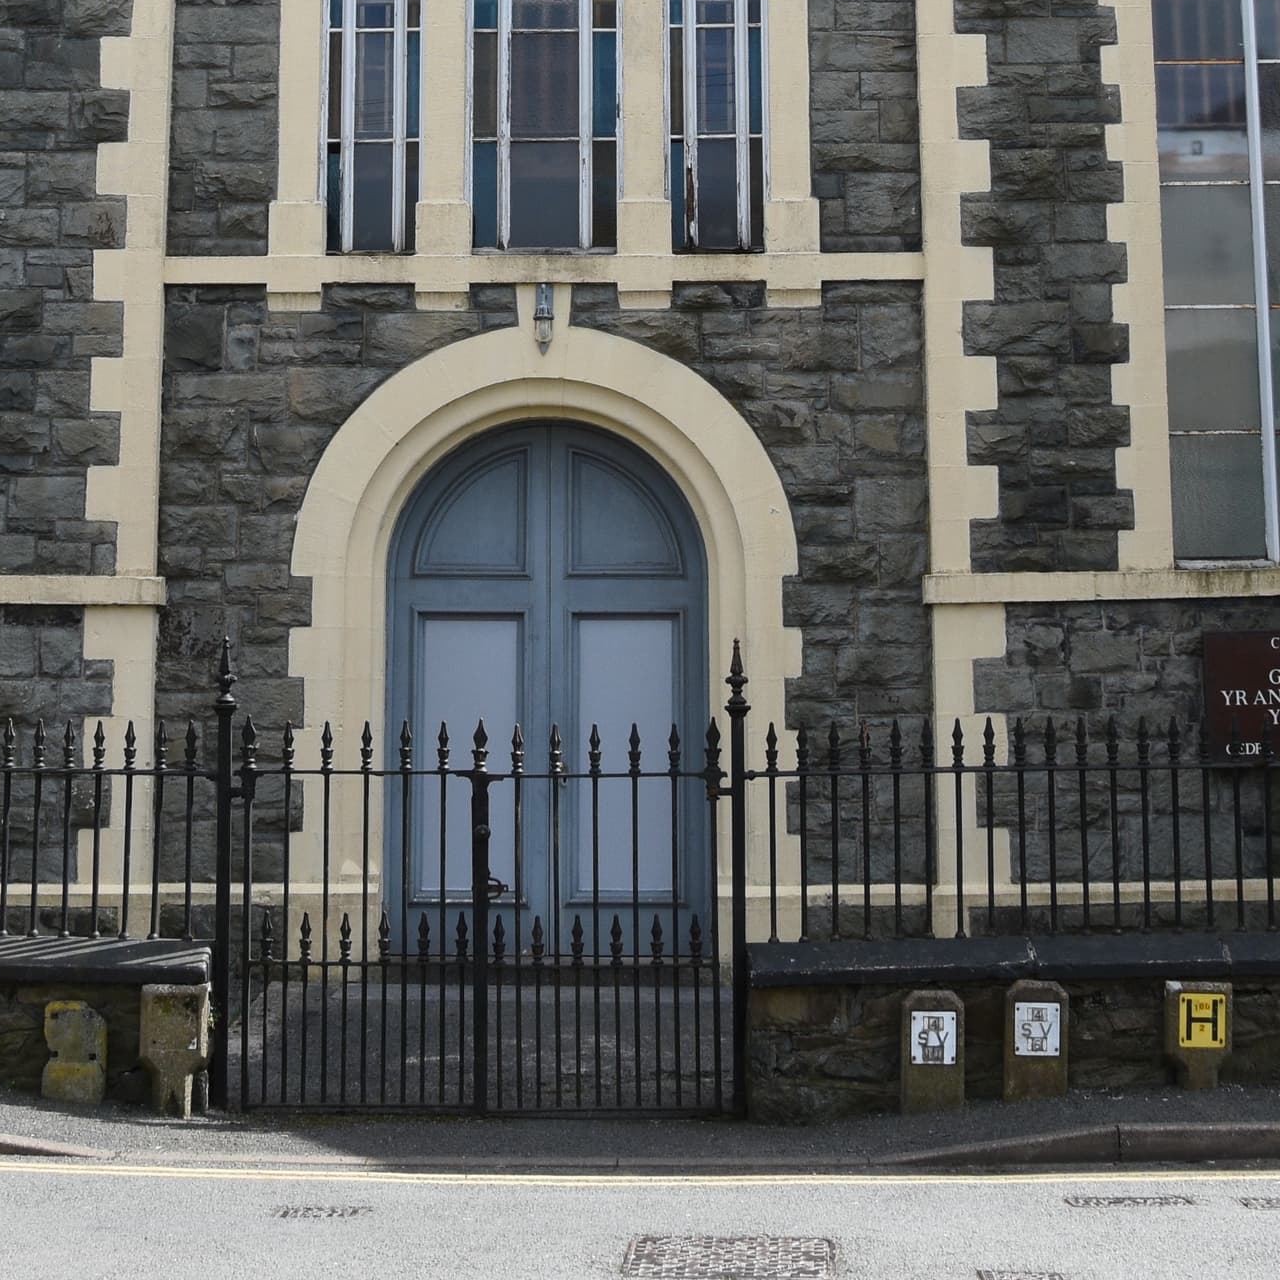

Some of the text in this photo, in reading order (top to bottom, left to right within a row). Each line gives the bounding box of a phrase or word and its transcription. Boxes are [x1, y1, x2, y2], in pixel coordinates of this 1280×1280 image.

[1221, 690, 1248, 706] YR
[1268, 709, 1280, 725] Y
[1186, 999, 1218, 1041] H
[1199, 1024, 1206, 1032] 2
